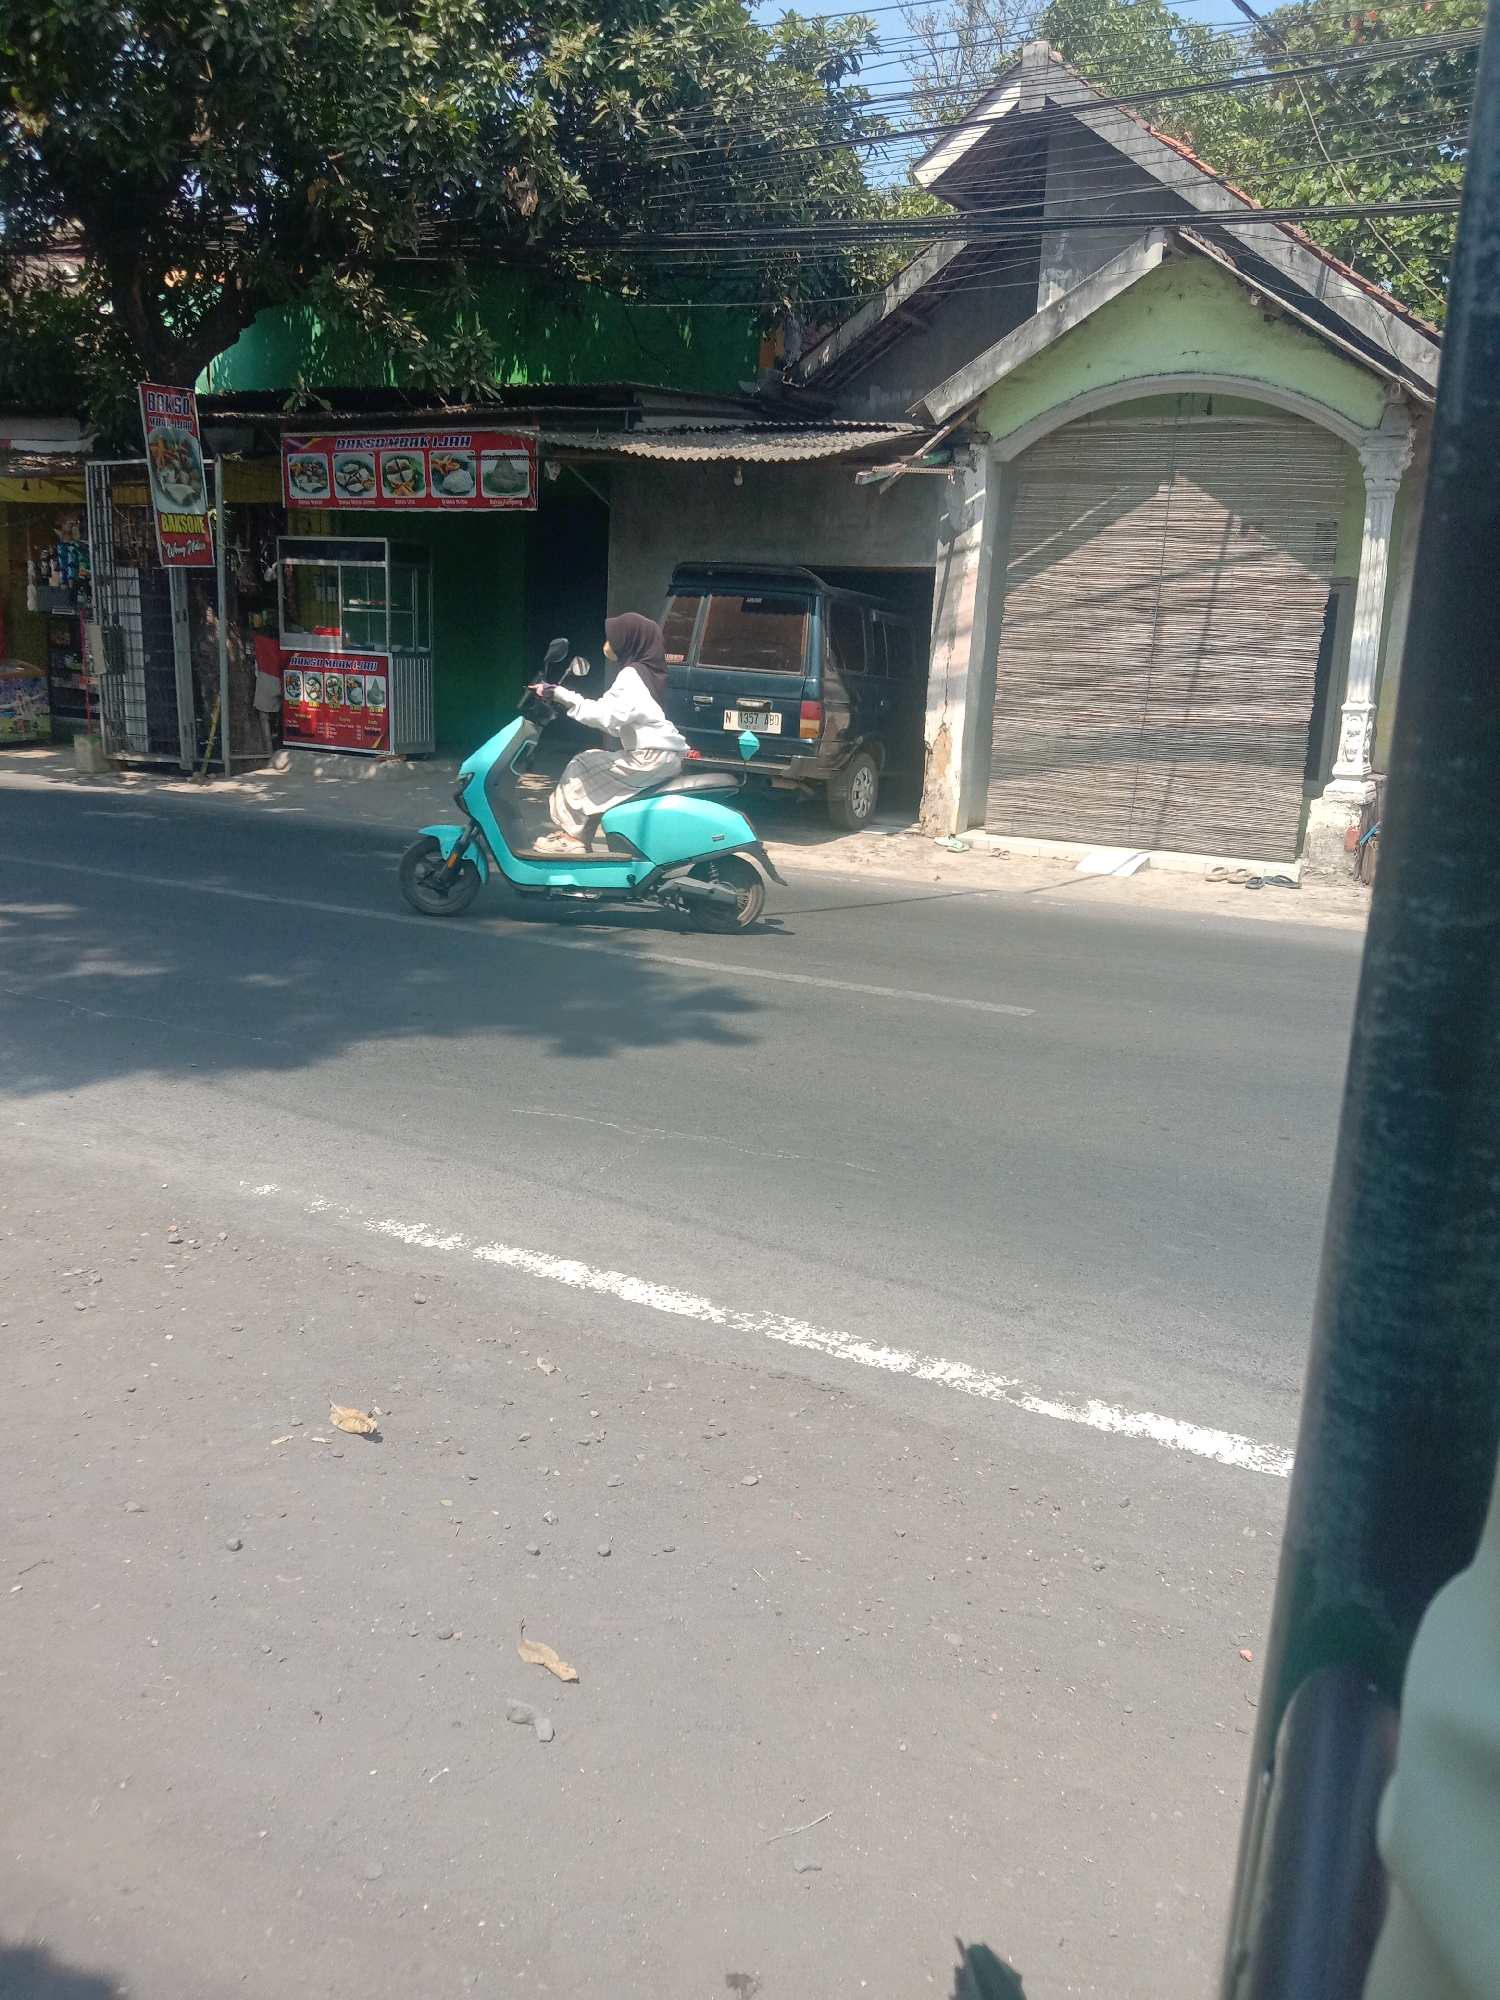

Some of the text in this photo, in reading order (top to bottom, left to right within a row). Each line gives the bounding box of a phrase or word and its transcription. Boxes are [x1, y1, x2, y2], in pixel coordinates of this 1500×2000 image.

[147, 391, 191, 416] BAKSO
[335, 435, 472, 450] BAKSO MBAK IJAH
[290, 656, 378, 671] BAKSO MBAK IJAH
[725, 711, 780, 726] N 1357 ABD
